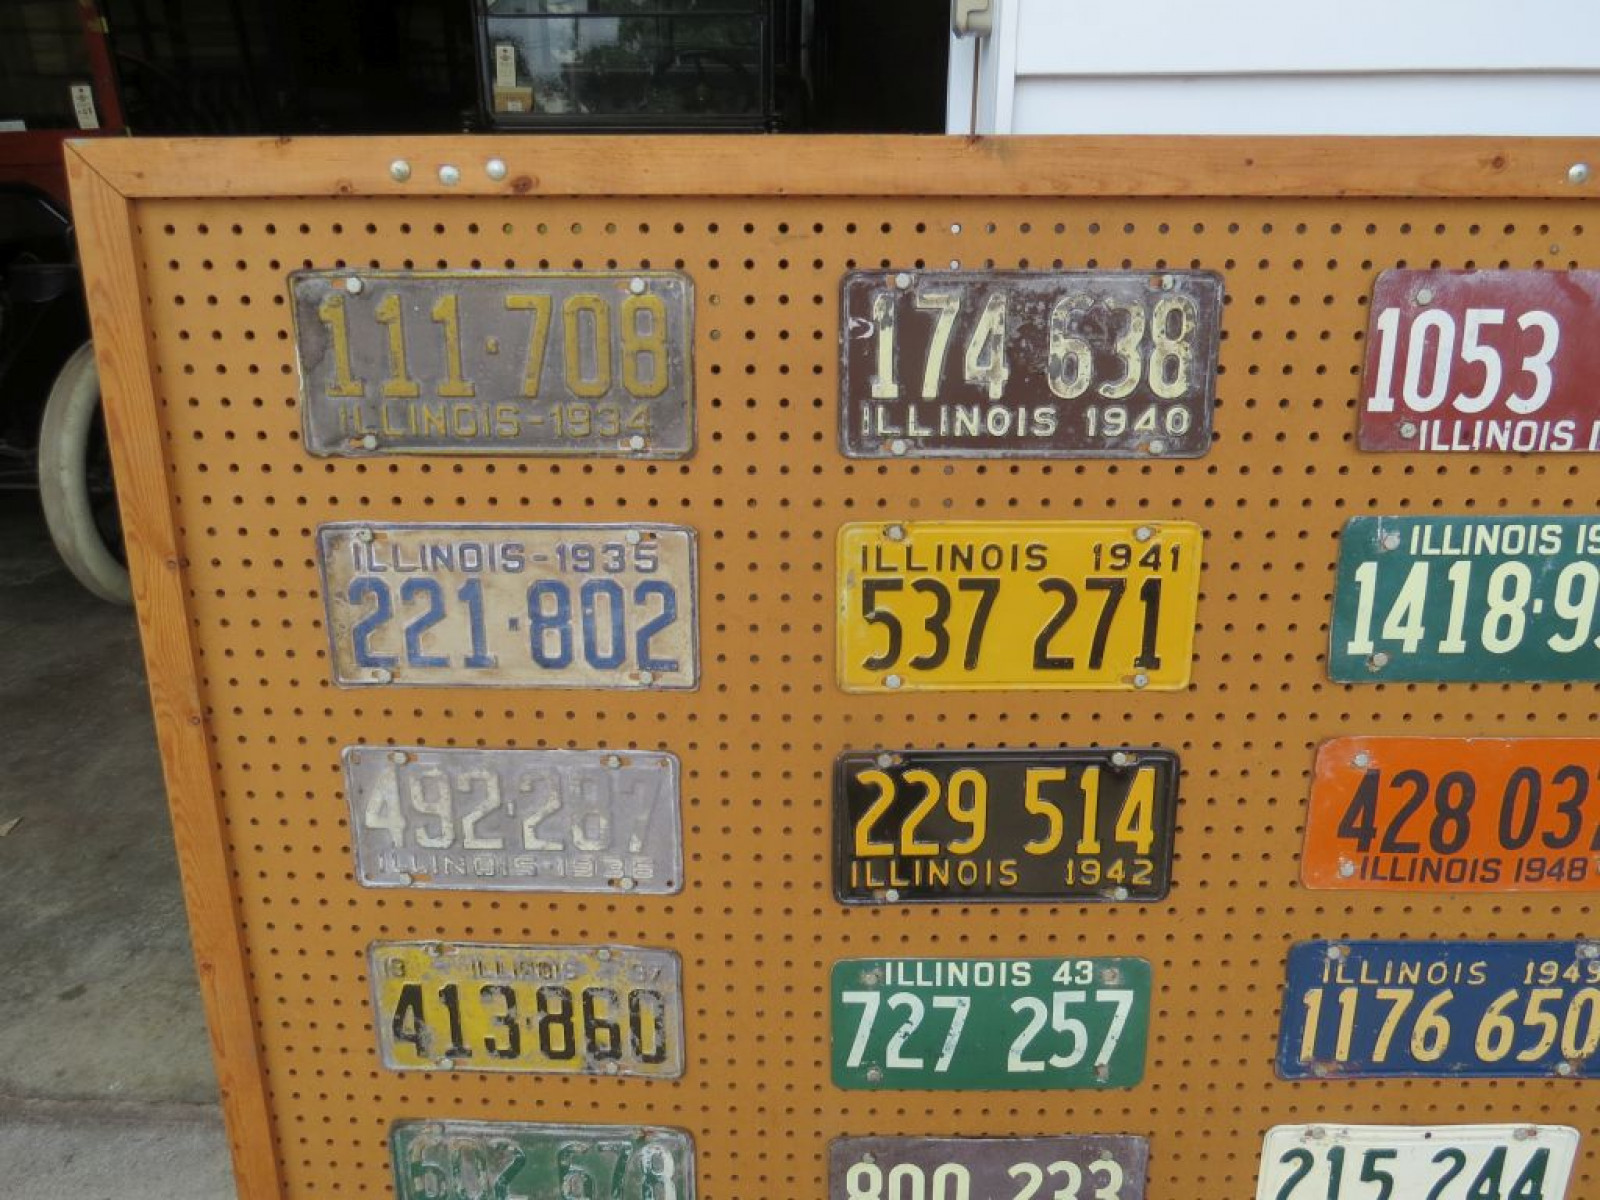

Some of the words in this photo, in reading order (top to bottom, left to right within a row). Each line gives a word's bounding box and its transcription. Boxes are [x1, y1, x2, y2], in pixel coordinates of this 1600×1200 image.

[871, 293, 1010, 400] 174
[1048, 294, 1199, 399] 638
[1367, 307, 1560, 414] 1053
[862, 406, 1056, 437] ILLINOIS
[1086, 406, 1191, 437] 1940
[1419, 419, 1576, 451] ILLINOIS
[861, 543, 1048, 572] ILLINOIS
[1092, 543, 1181, 572] 1941
[1410, 524, 1563, 555] ILLINOIS
[861, 577, 1001, 671] 537
[1033, 577, 1162, 671] 271
[855, 767, 988, 857] 229
[1023, 766, 1156, 855] 514
[1337, 768, 1477, 855] 428
[1499, 764, 1600, 852] 03
[851, 858, 1019, 887] ILLINOIS
[1065, 858, 1155, 887] 1942
[1359, 856, 1503, 884] ILLINOIS
[1513, 857, 1589, 883] 1948
[885, 961, 1032, 987] ILLINOIS
[1052, 960, 1094, 985] 43
[1322, 960, 1489, 985] ILLINOIS
[1523, 960, 1600, 985] 1949
[842, 991, 971, 1072] 727
[1007, 990, 1134, 1072] 257
[1300, 987, 1454, 1062] 1176
[1474, 987, 1600, 1062] 650
[1279, 1145, 1398, 1200] 215
[1430, 1145, 1551, 1200] 244
